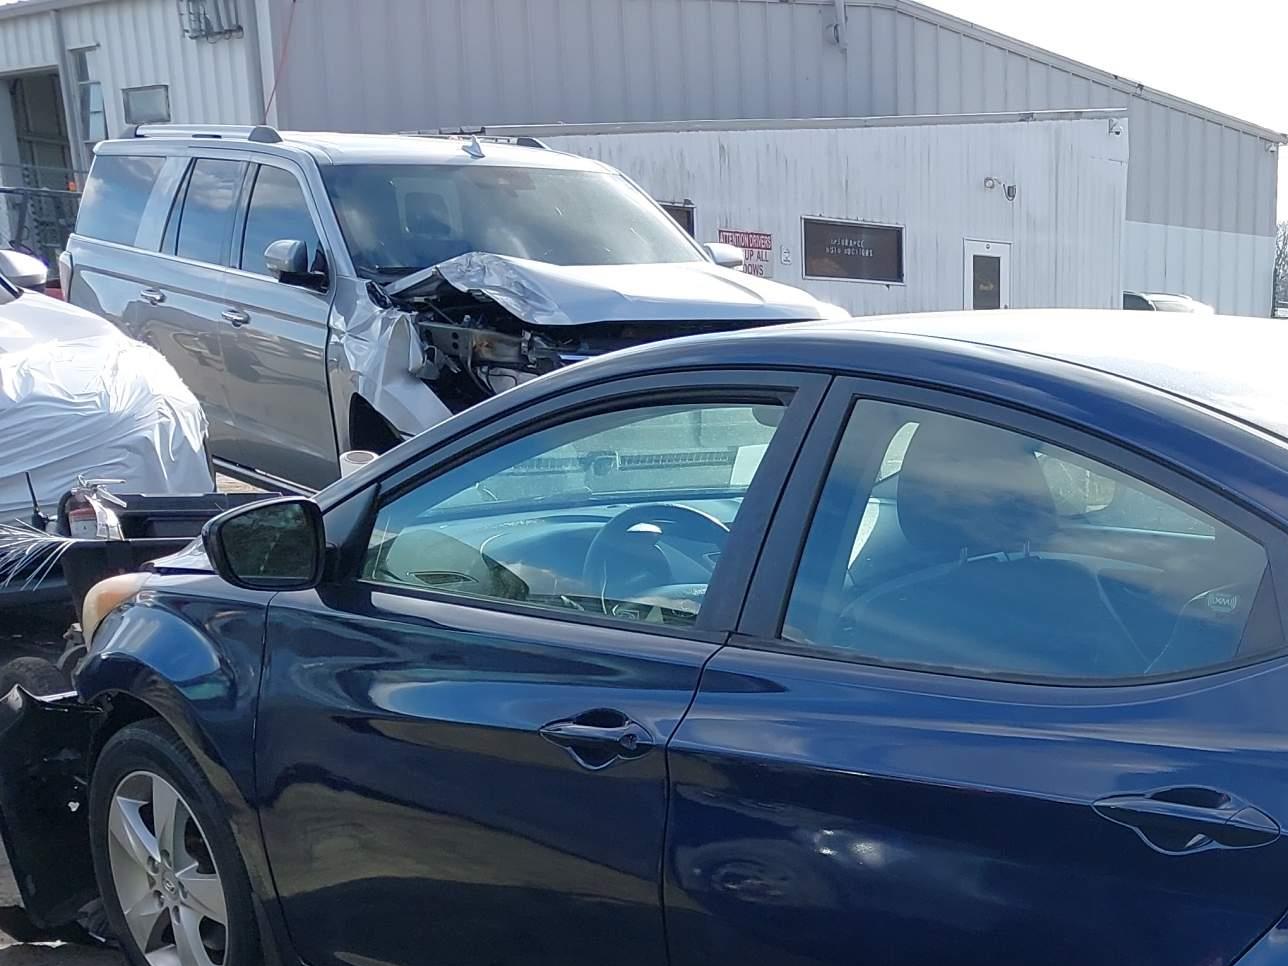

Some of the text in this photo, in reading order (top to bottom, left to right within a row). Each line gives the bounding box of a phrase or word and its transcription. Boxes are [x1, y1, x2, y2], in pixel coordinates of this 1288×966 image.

[720, 231, 771, 249] ATTENTION DRIVERS
[744, 250, 769, 262] UP ALL
[743, 263, 764, 276] DOWS
